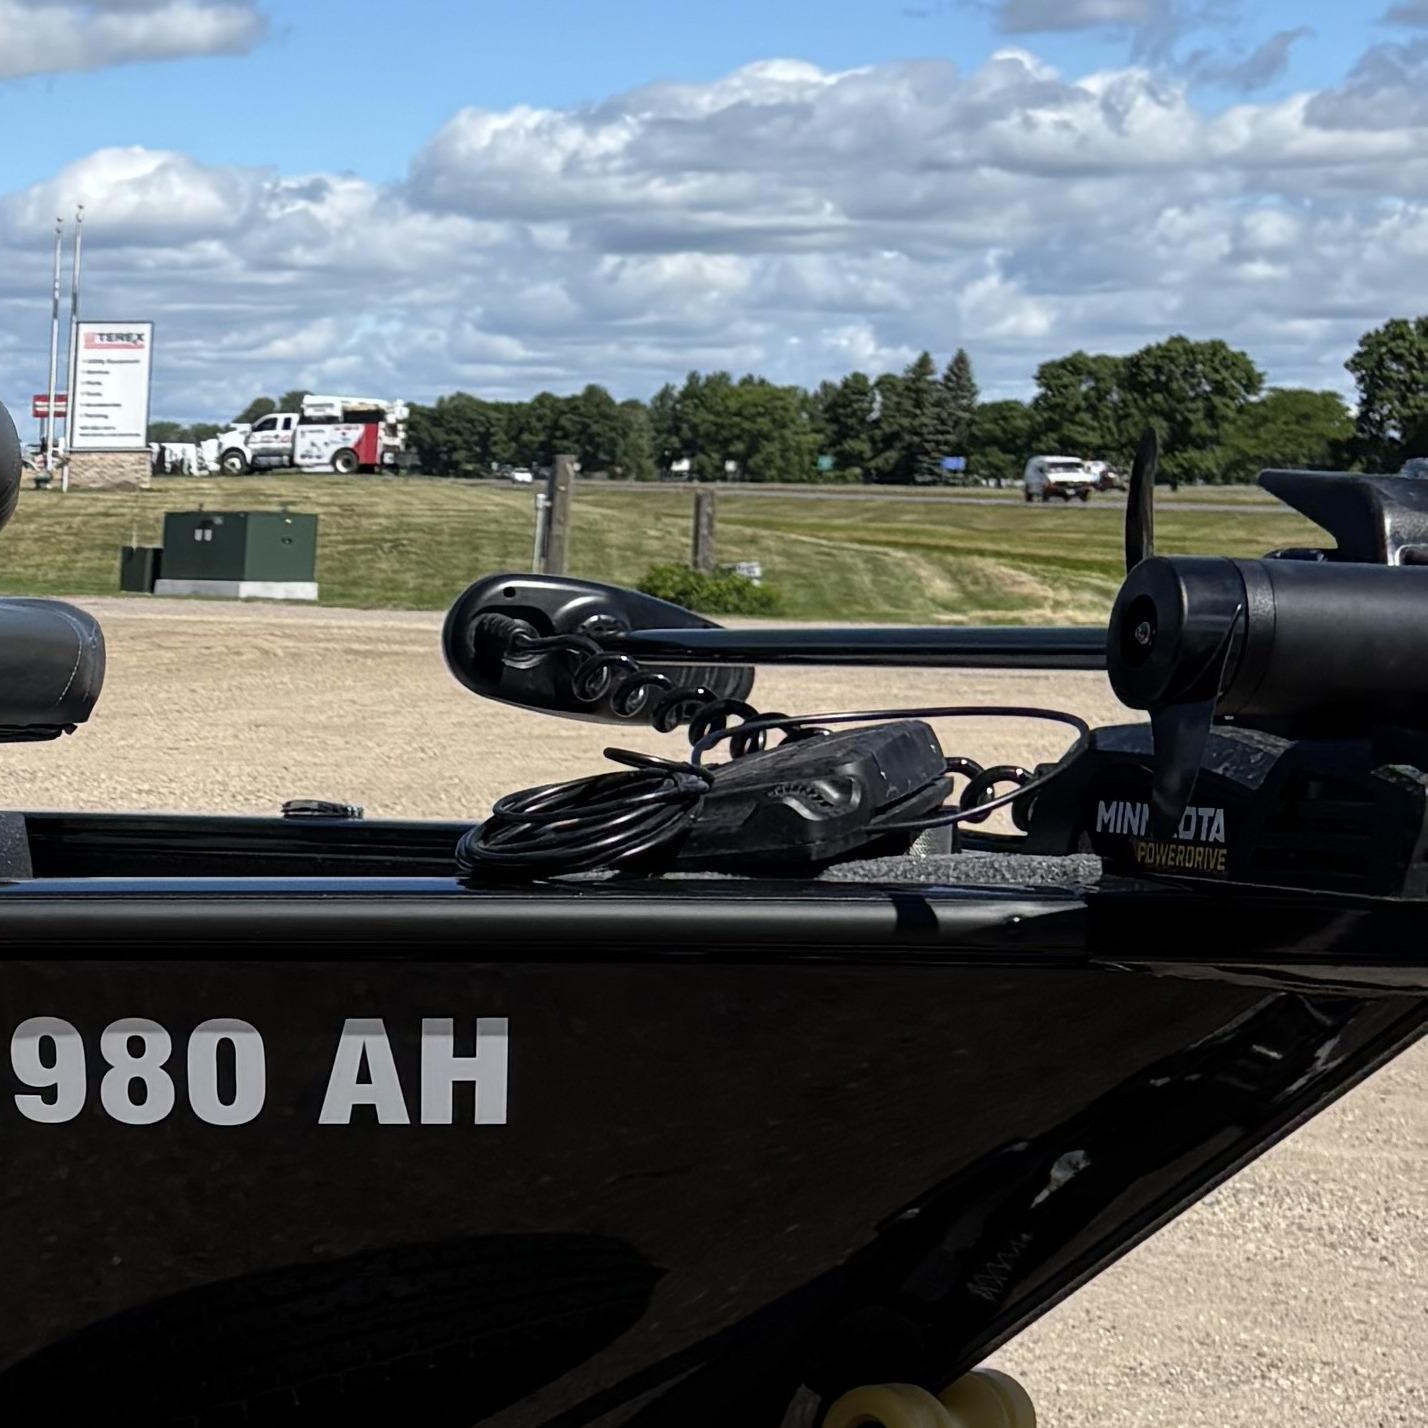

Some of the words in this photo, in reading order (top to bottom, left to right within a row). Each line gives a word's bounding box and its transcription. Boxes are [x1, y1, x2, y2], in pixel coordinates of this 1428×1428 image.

[98, 332, 144, 345] TEREX
[1172, 806, 1226, 842] OTA
[1136, 842, 1227, 871] POWERDRIVE
[318, 1017, 509, 1125] AH
